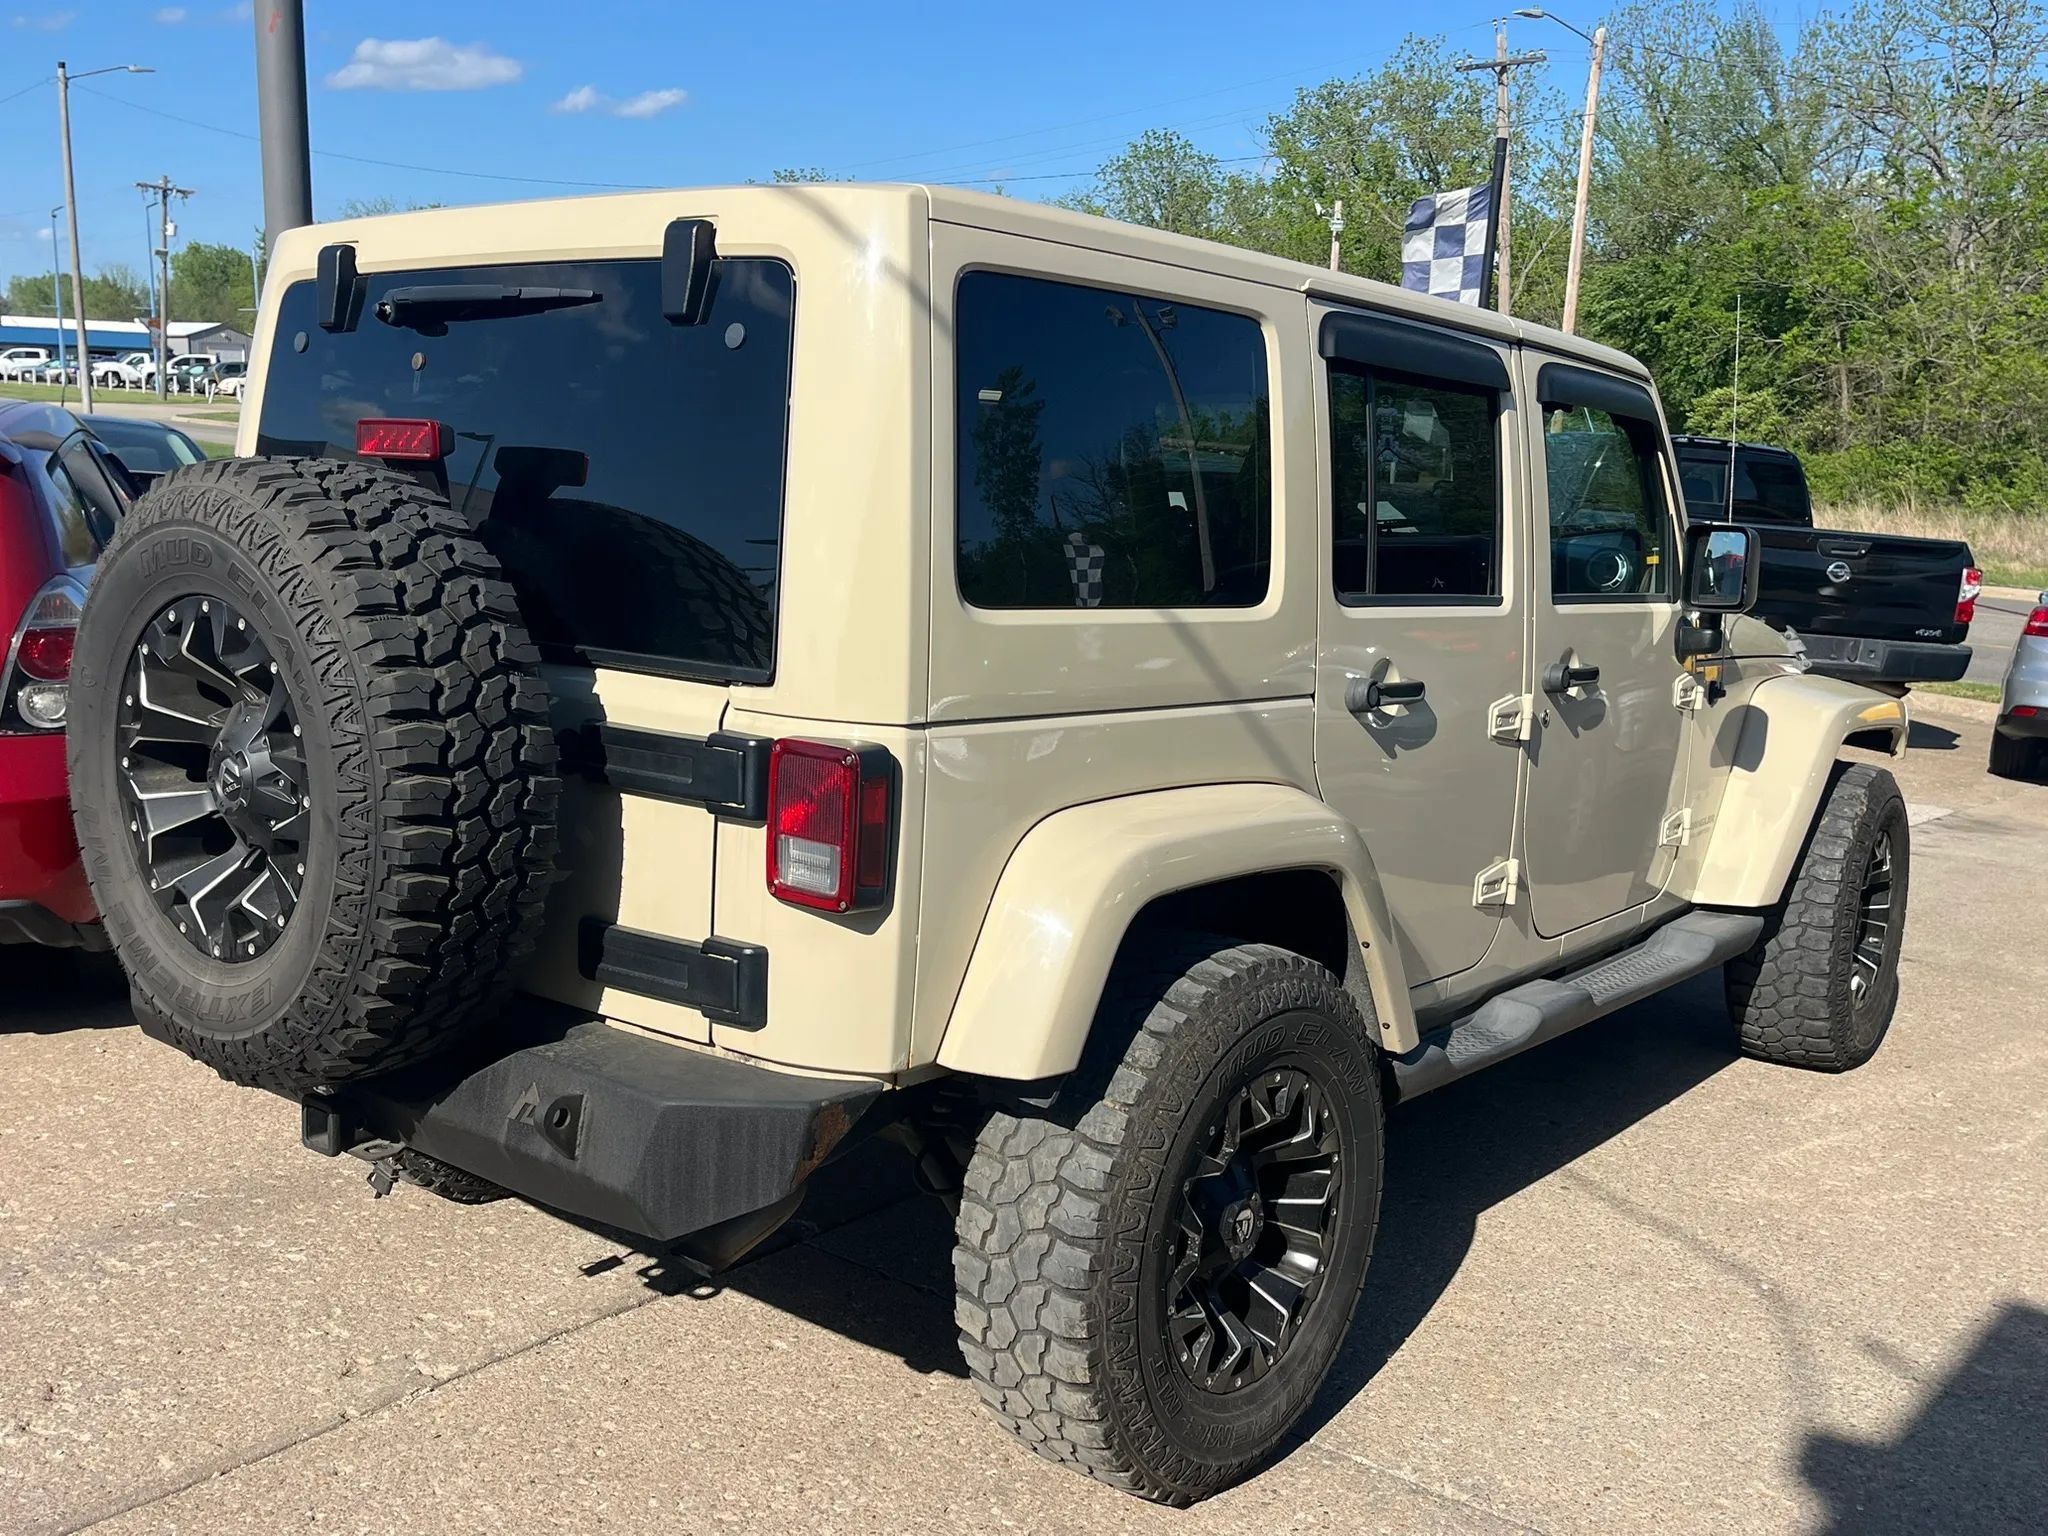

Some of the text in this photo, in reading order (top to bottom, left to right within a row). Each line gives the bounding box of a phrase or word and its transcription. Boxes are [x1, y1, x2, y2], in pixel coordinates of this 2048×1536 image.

[140, 535, 316, 720] MUD CLAW
[108, 902, 273, 1025] EXTREME
[1215, 1021, 1368, 1099] MUD CLAW
[1148, 1357, 1184, 1420] MT
